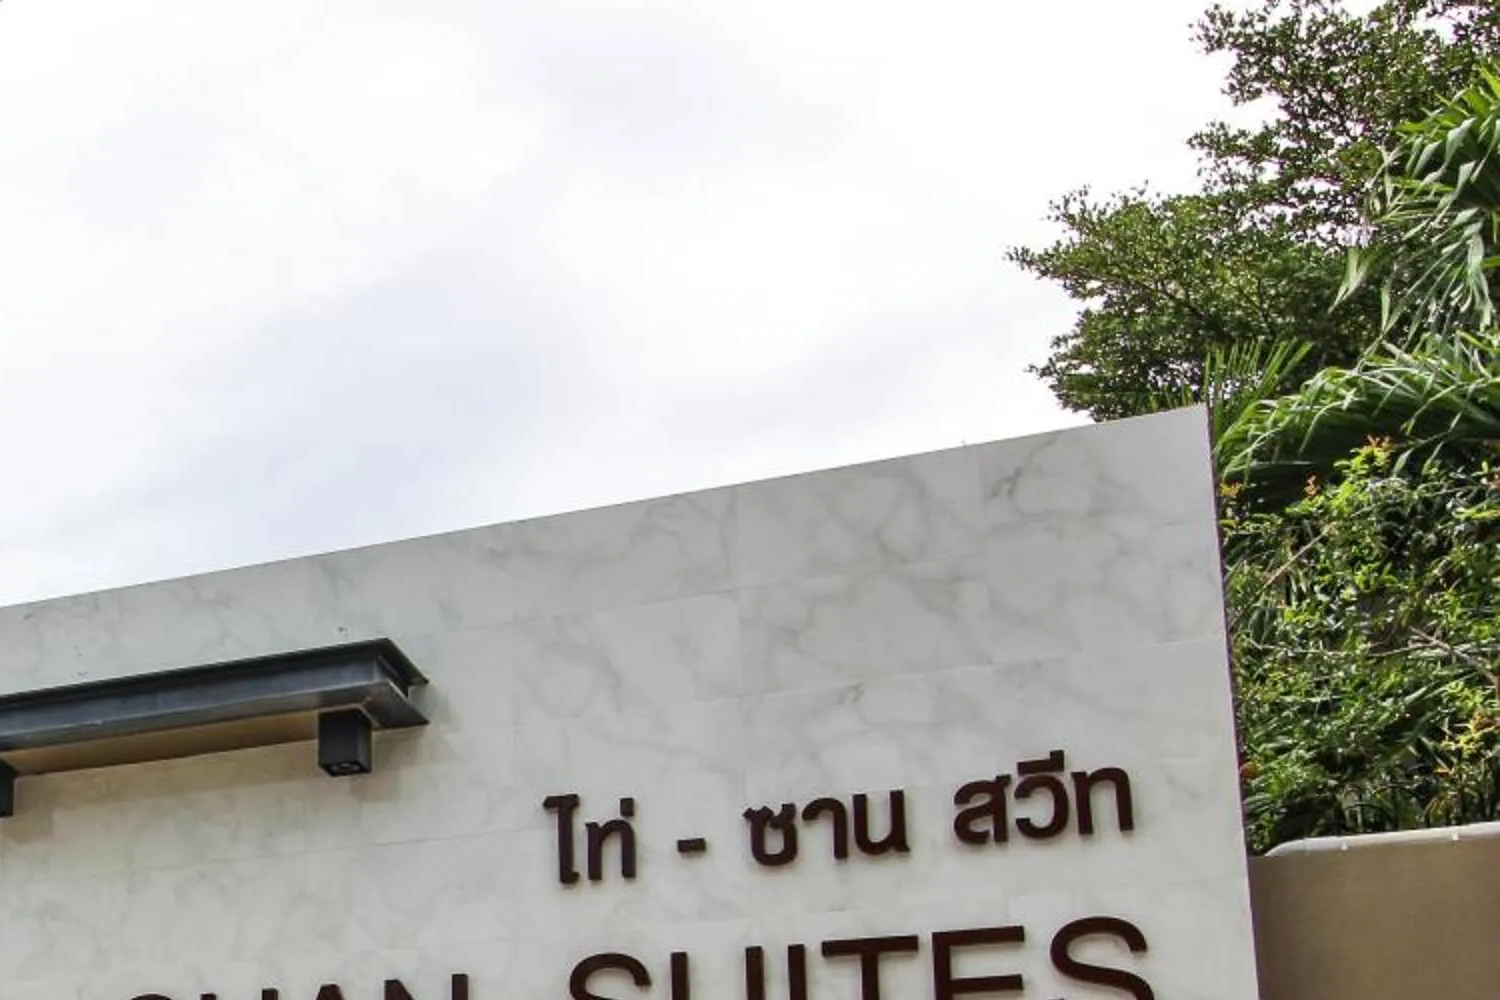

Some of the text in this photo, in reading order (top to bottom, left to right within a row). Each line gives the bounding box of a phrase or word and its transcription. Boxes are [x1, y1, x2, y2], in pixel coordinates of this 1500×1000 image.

[542, 793, 638, 889] ไท่
[742, 789, 912, 870] ซาน
[953, 749, 1136, 849] สวีท
